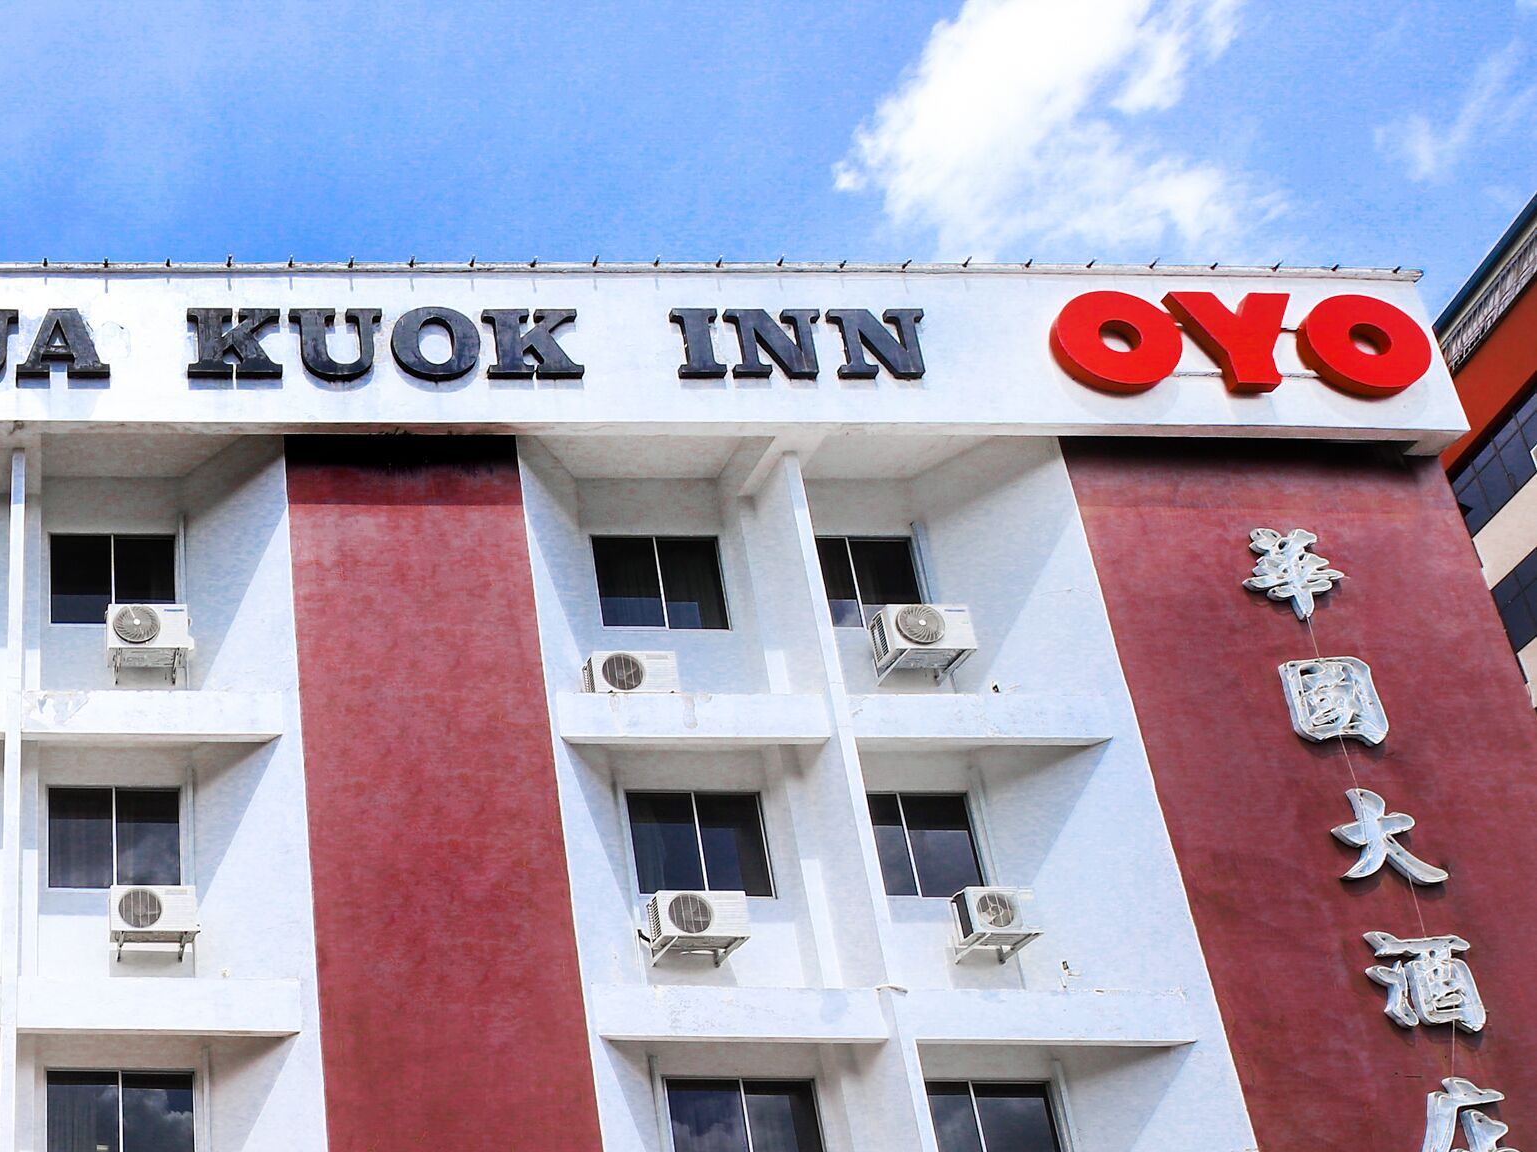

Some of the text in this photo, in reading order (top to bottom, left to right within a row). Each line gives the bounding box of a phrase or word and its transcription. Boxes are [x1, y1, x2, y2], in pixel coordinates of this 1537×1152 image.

[187, 306, 584, 381] KUOK
[668, 307, 925, 380] INN
[1050, 290, 1432, 402] OYO
